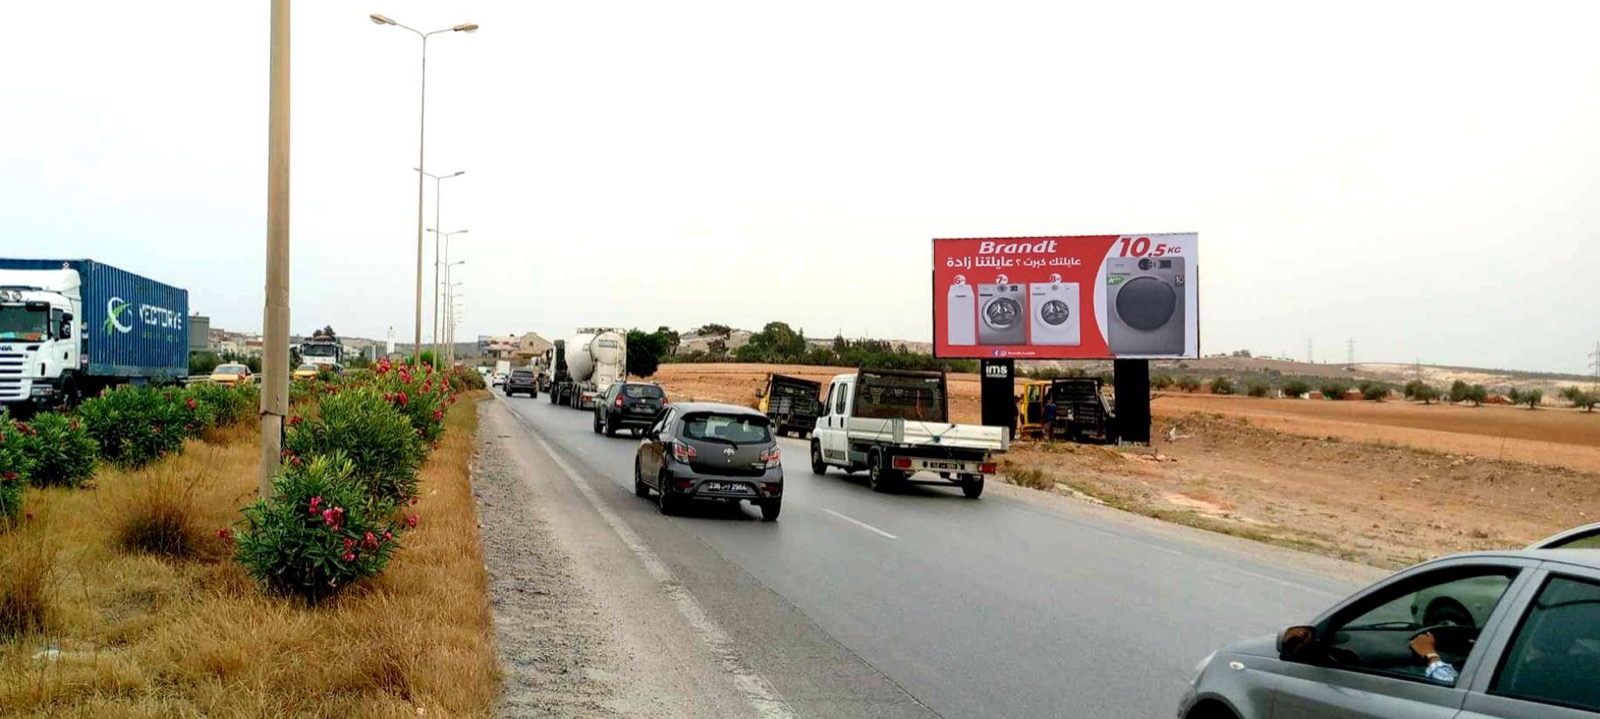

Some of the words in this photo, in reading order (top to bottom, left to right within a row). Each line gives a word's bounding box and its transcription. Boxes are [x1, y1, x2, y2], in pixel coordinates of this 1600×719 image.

[979, 240, 1058, 254] Brandt
[1167, 246, 1182, 254] KG
[946, 257, 972, 270] زادة
[975, 256, 1014, 270] عايلتنا
[985, 361, 1008, 375] ims
